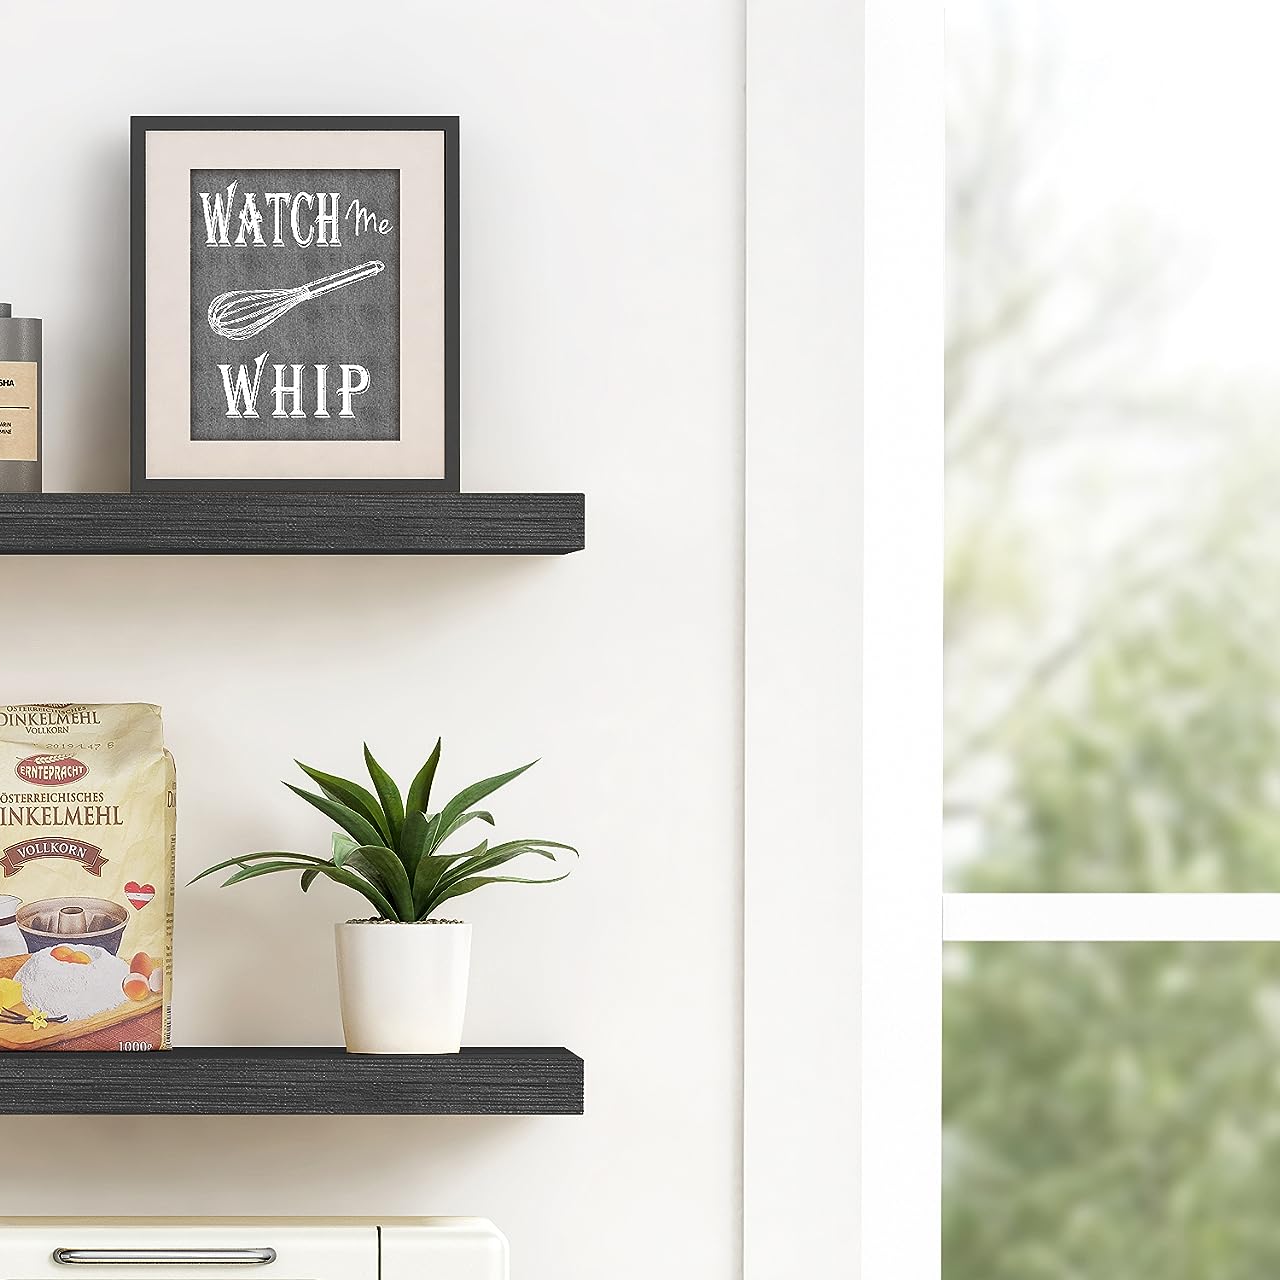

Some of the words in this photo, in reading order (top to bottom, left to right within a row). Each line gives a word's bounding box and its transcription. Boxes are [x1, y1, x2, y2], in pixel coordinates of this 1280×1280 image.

[196, 179, 341, 247] WATCH
[345, 199, 394, 236] Me
[217, 350, 371, 419] WHIP
[25, 726, 70, 734] VOLLKORN
[20, 765, 85, 781] ERNTEPRACHT
[0, 792, 104, 804] ÖSTERREICHISCHES
[16, 842, 88, 859] VOLLKORN
